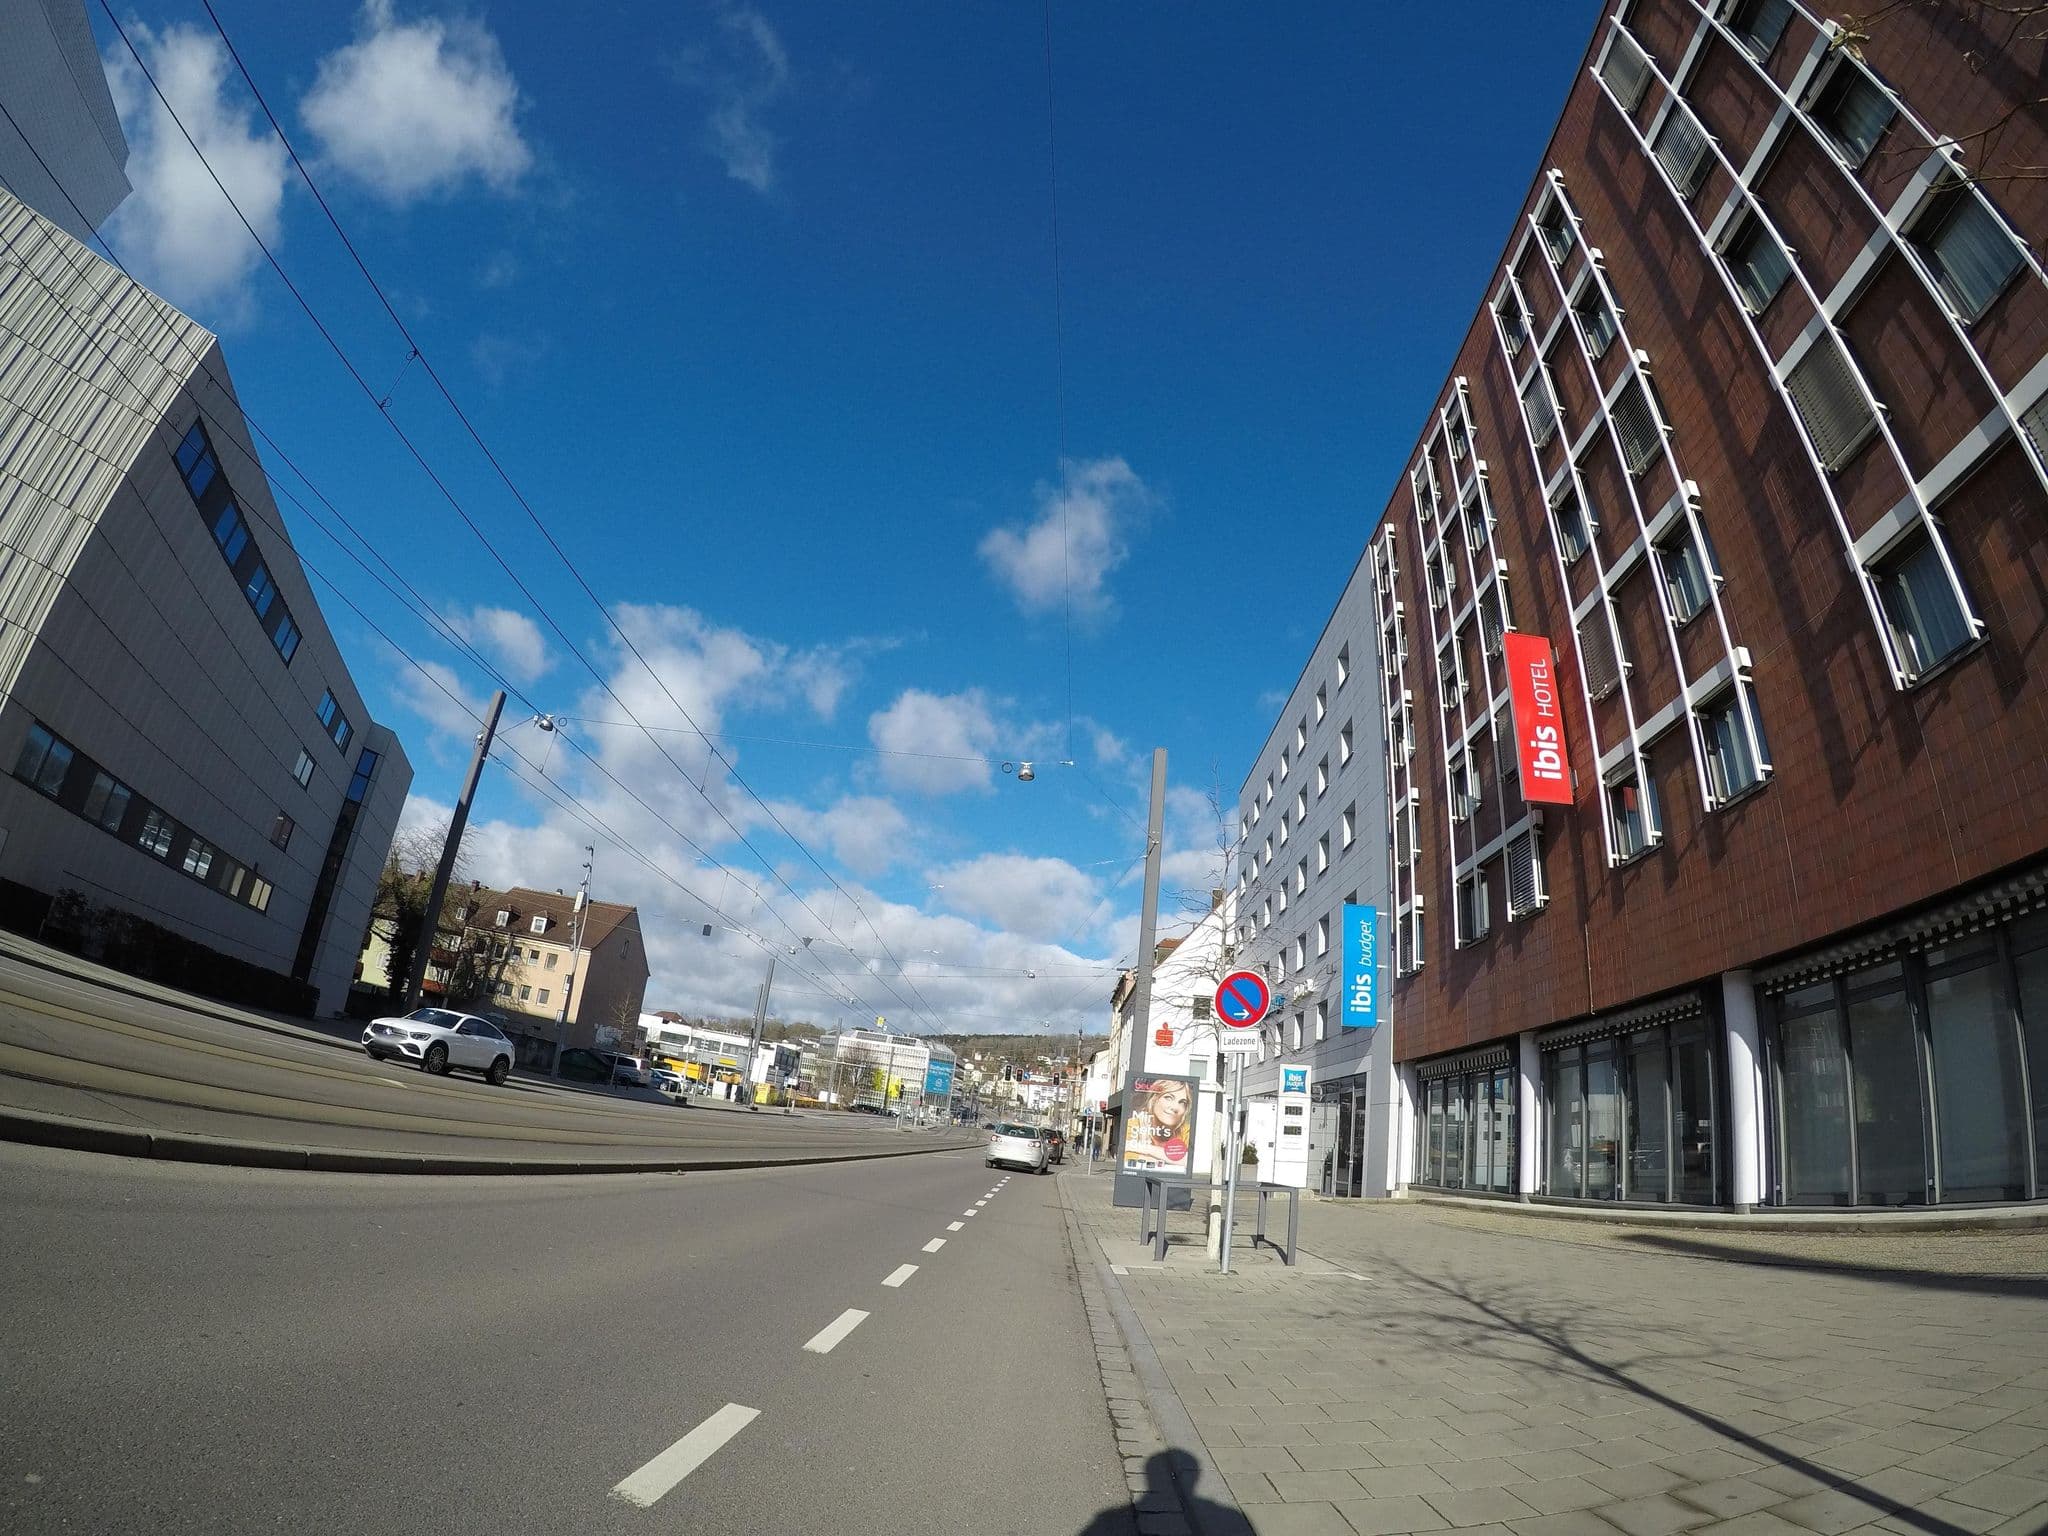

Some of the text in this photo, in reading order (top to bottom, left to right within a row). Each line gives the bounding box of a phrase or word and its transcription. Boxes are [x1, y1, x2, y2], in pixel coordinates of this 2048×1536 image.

[1530, 659, 1563, 780] ibis HOTEL
[1351, 919, 1376, 1013] ibis budget
[1223, 1036, 1256, 1046] Ladezone
[1288, 1073, 1303, 1081] ibis
